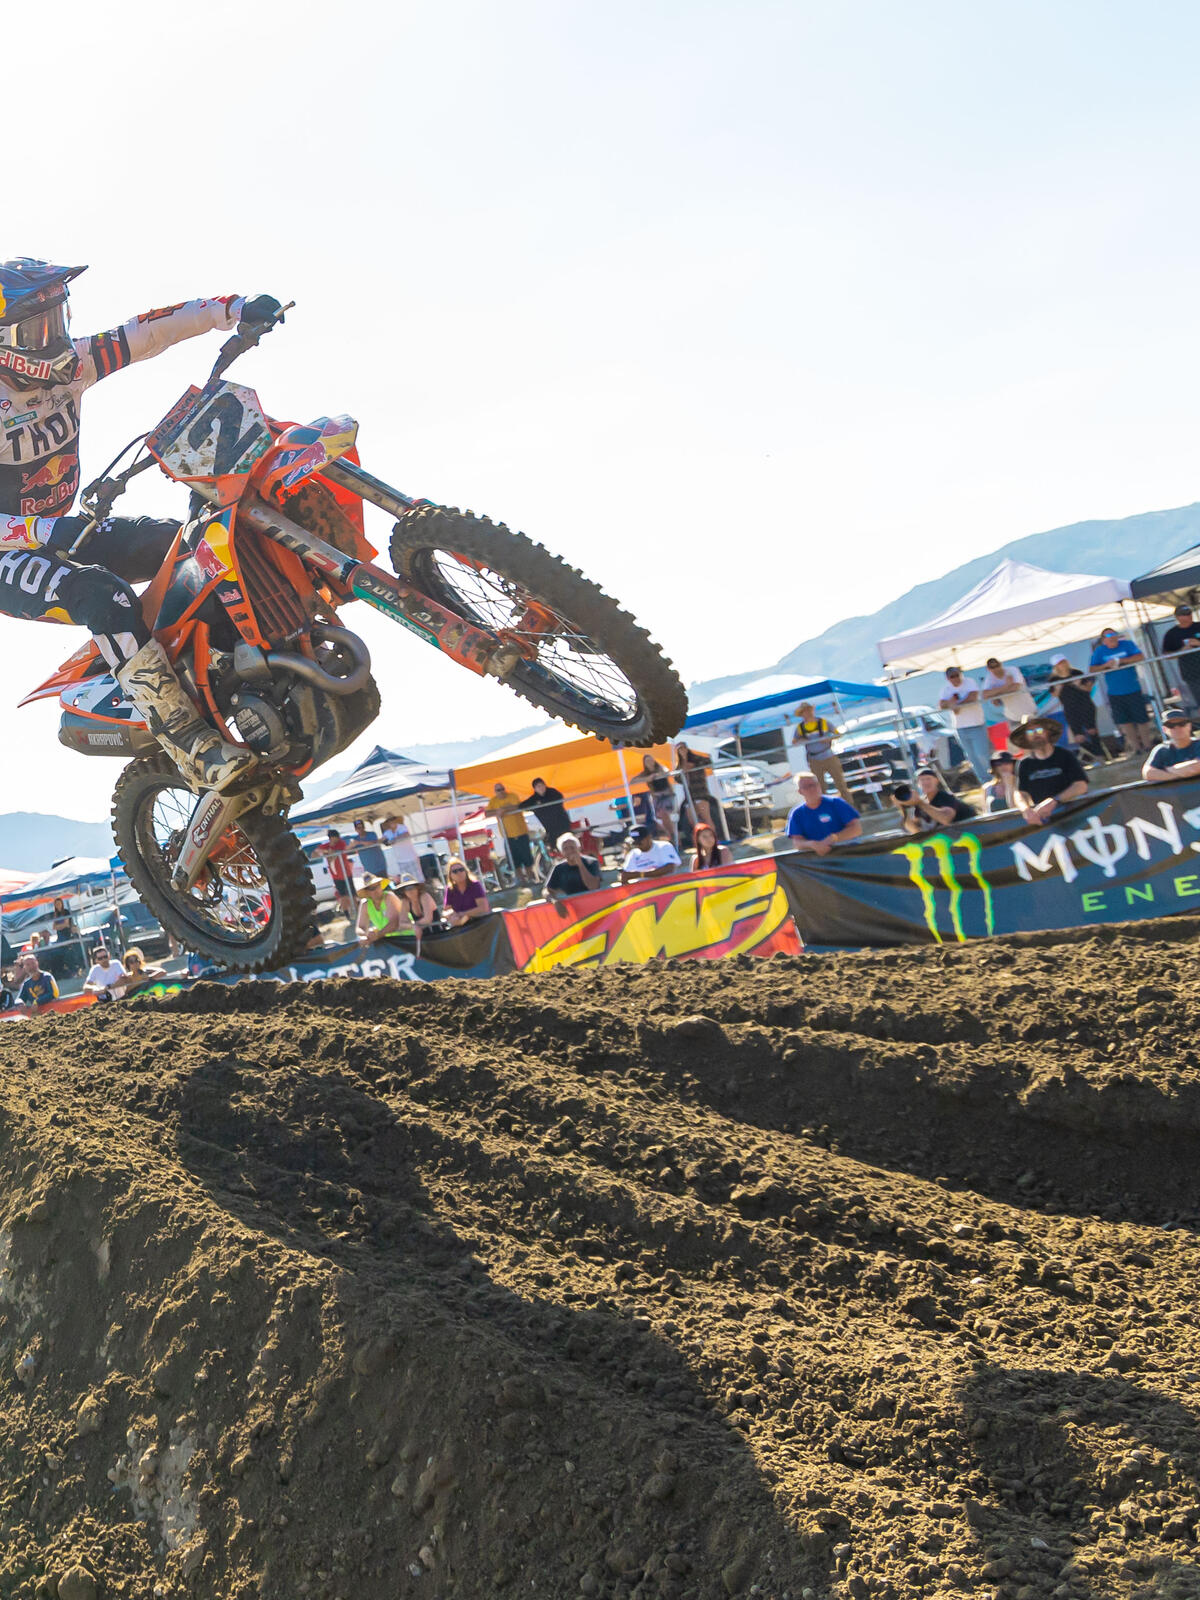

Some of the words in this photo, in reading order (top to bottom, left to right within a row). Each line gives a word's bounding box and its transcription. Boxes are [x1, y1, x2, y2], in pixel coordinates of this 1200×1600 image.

[12, 355, 52, 380] Bull
[187, 391, 265, 475] 2
[20, 479, 57, 516] Red
[57, 467, 80, 503] Bul
[192, 799, 222, 848] RENTHAL
[1081, 875, 1200, 913] ENE
